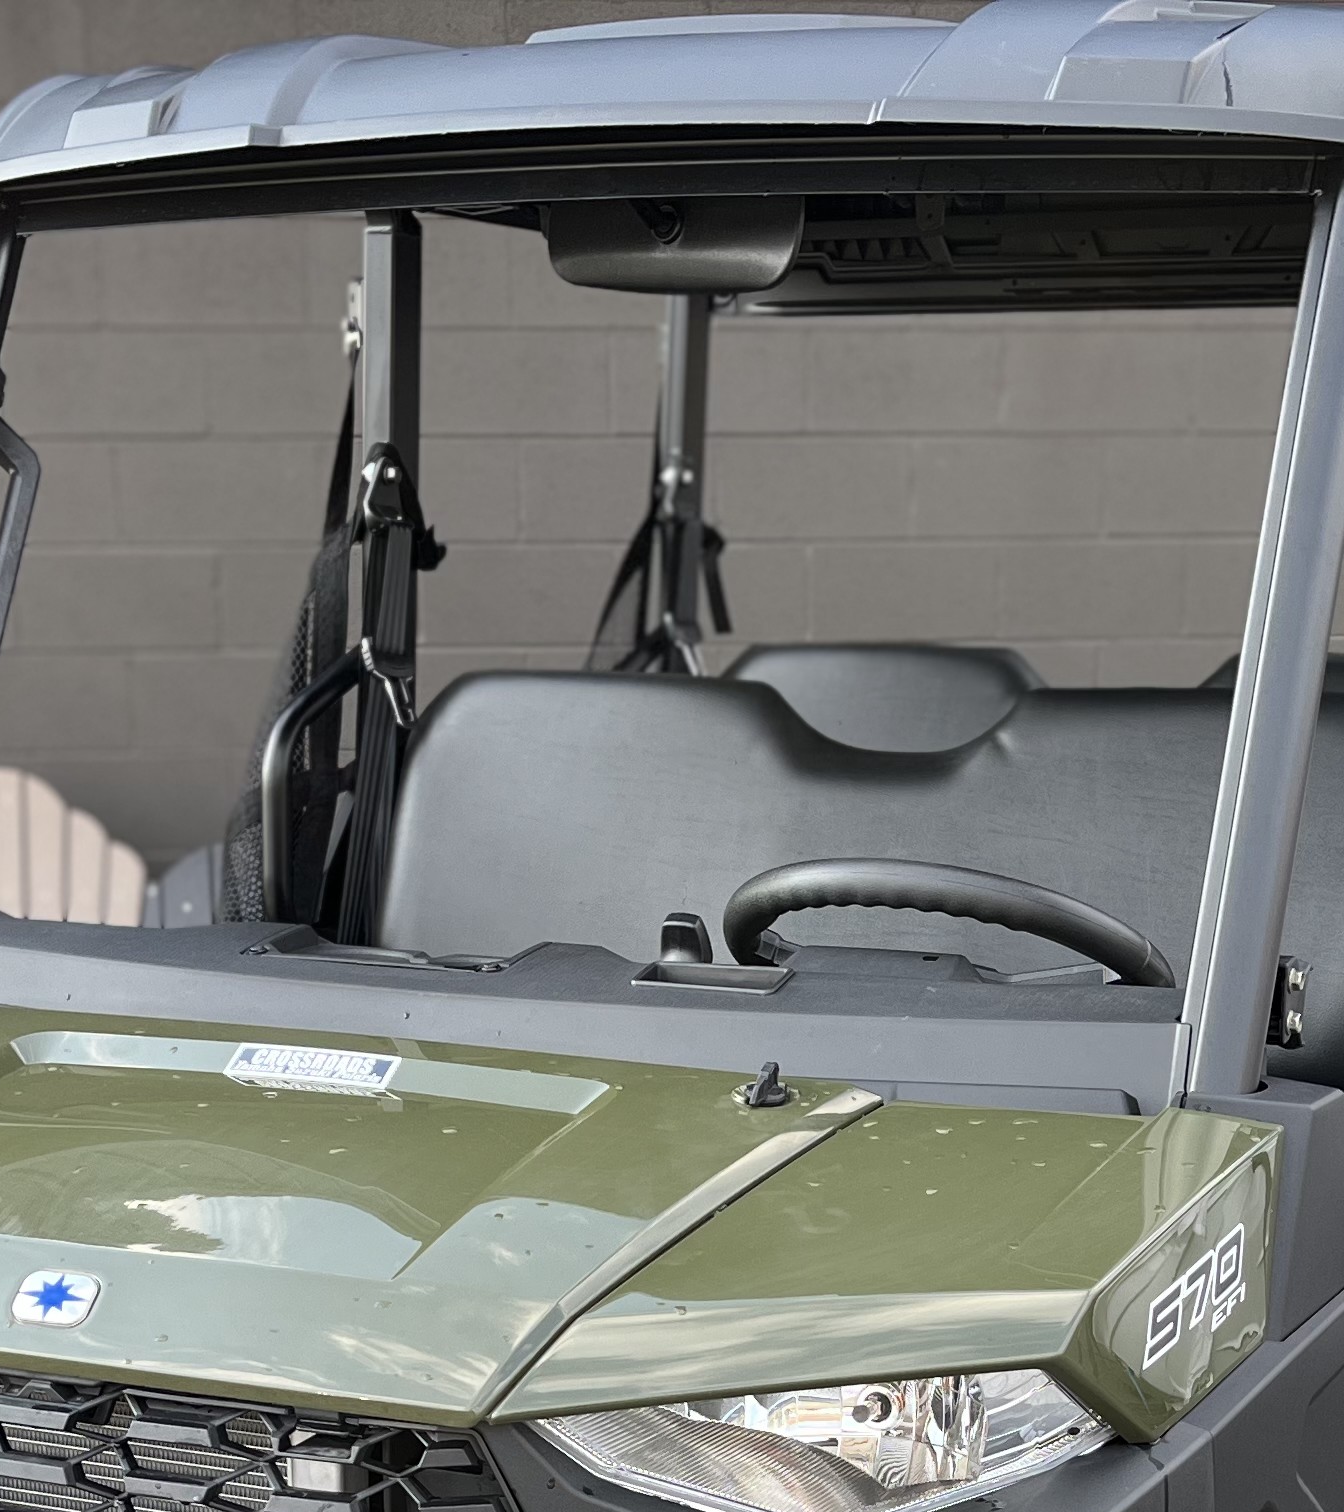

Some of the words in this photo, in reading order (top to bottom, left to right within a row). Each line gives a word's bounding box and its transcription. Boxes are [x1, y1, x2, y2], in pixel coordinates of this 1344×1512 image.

[250, 1048, 377, 1074] CROSSROADS
[1142, 1222, 1245, 1371] 570
[1210, 1281, 1247, 1333] EFI
